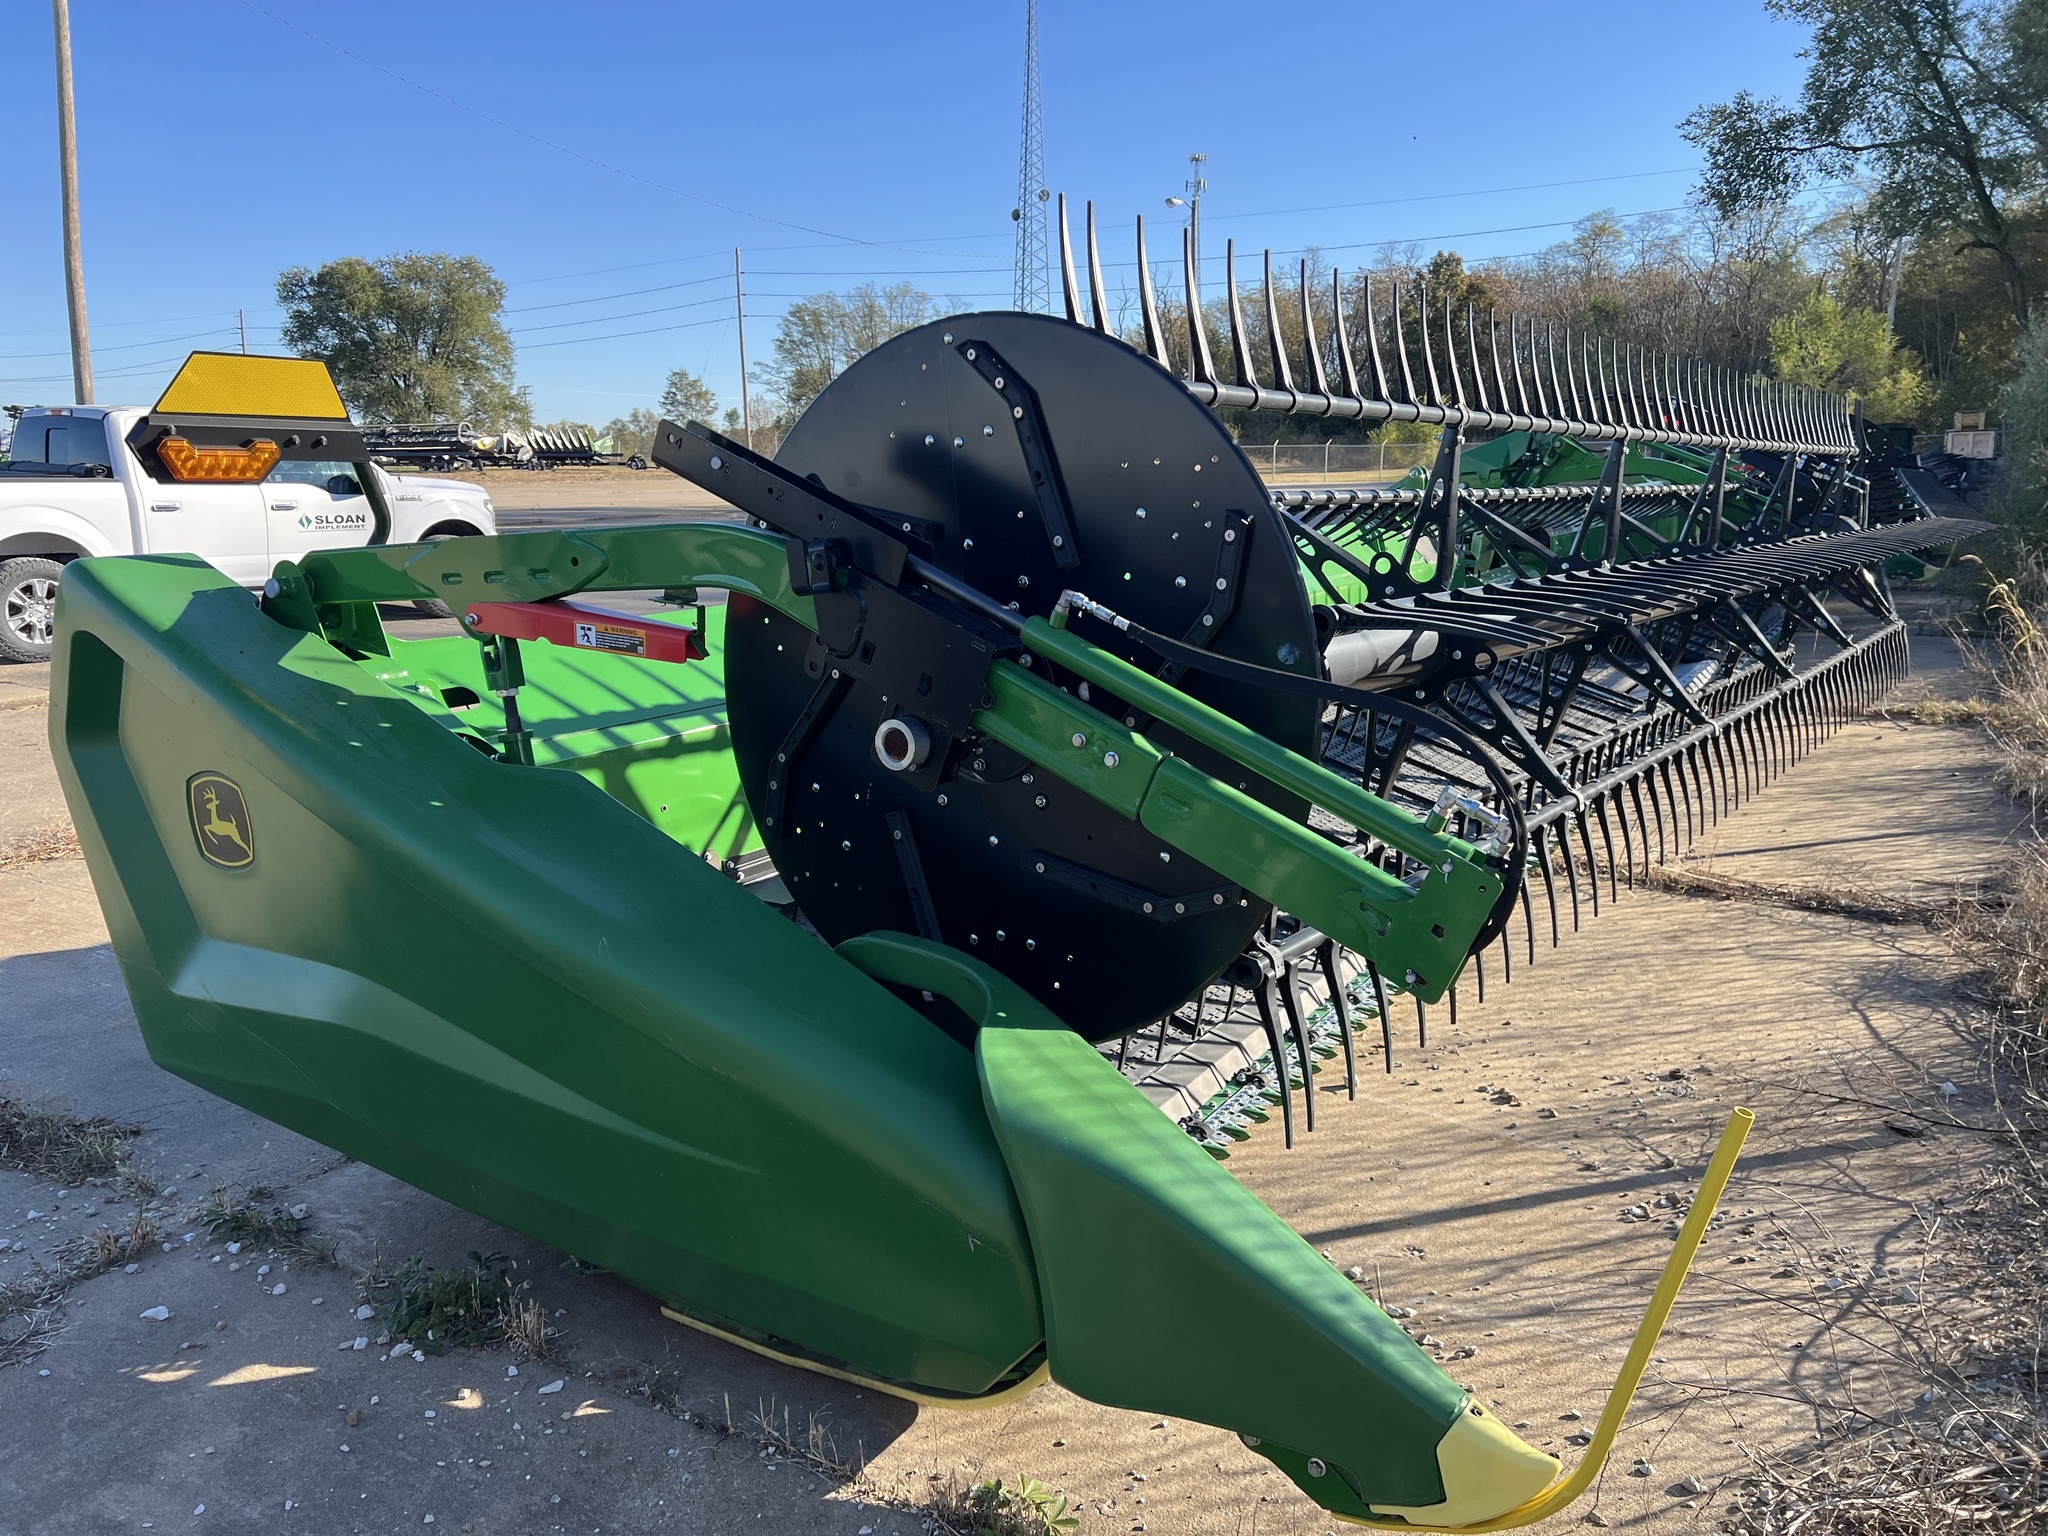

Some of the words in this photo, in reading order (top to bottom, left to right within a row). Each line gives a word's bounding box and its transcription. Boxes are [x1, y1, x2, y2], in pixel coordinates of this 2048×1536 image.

[675, 438, 682, 450] 4
[724, 462, 731, 474] 3
[775, 490, 785, 503] 2
[314, 514, 366, 524] SLOAN
[610, 626, 637, 636] WARNING
